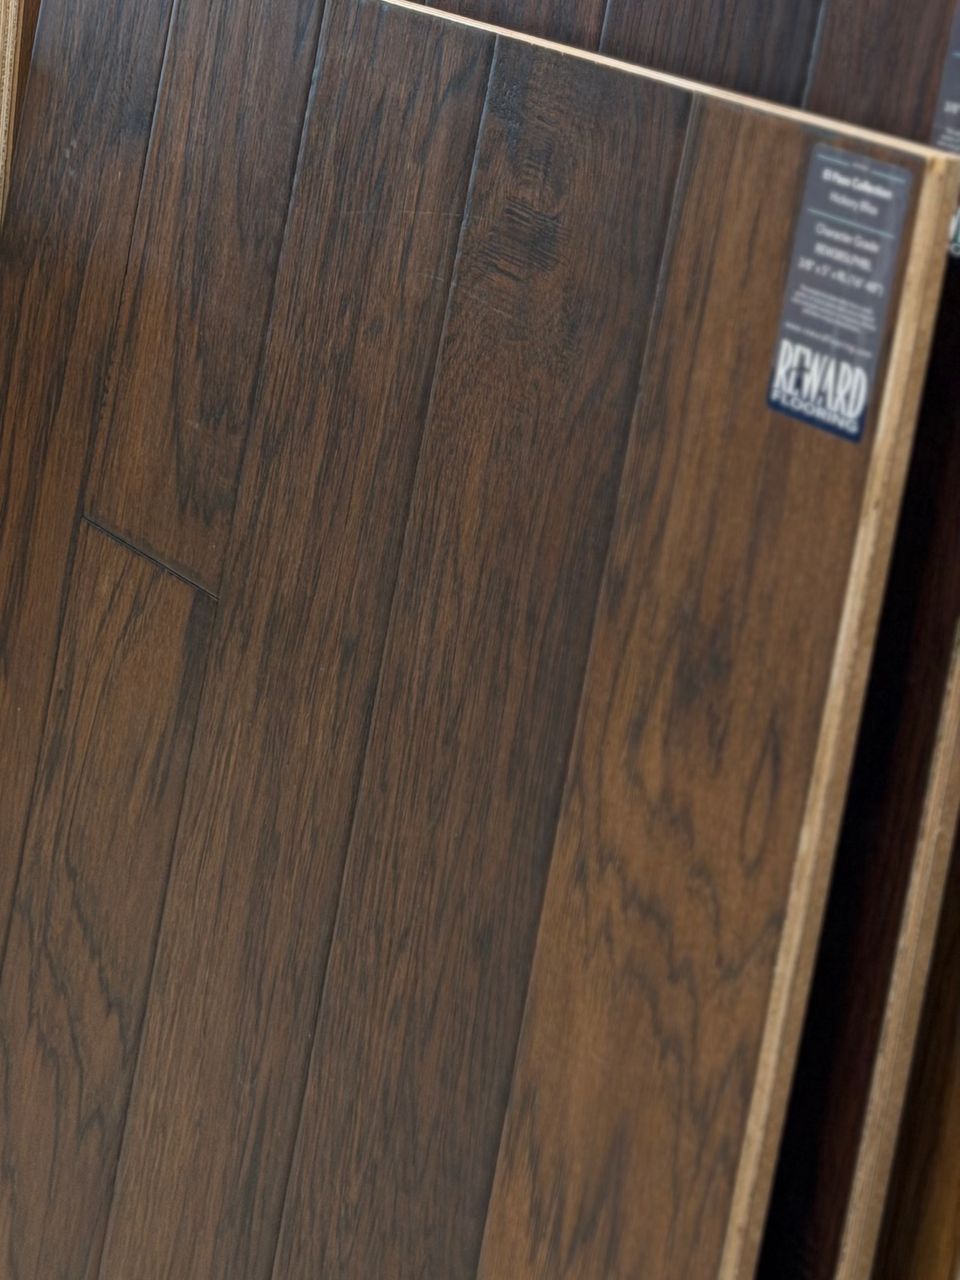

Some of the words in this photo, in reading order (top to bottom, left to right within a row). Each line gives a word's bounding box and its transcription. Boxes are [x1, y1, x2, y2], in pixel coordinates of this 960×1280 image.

[851, 177, 893, 200] Collection
[815, 222, 853, 244] Character
[774, 338, 868, 419] REWARD
[771, 387, 859, 434] FLOORING
